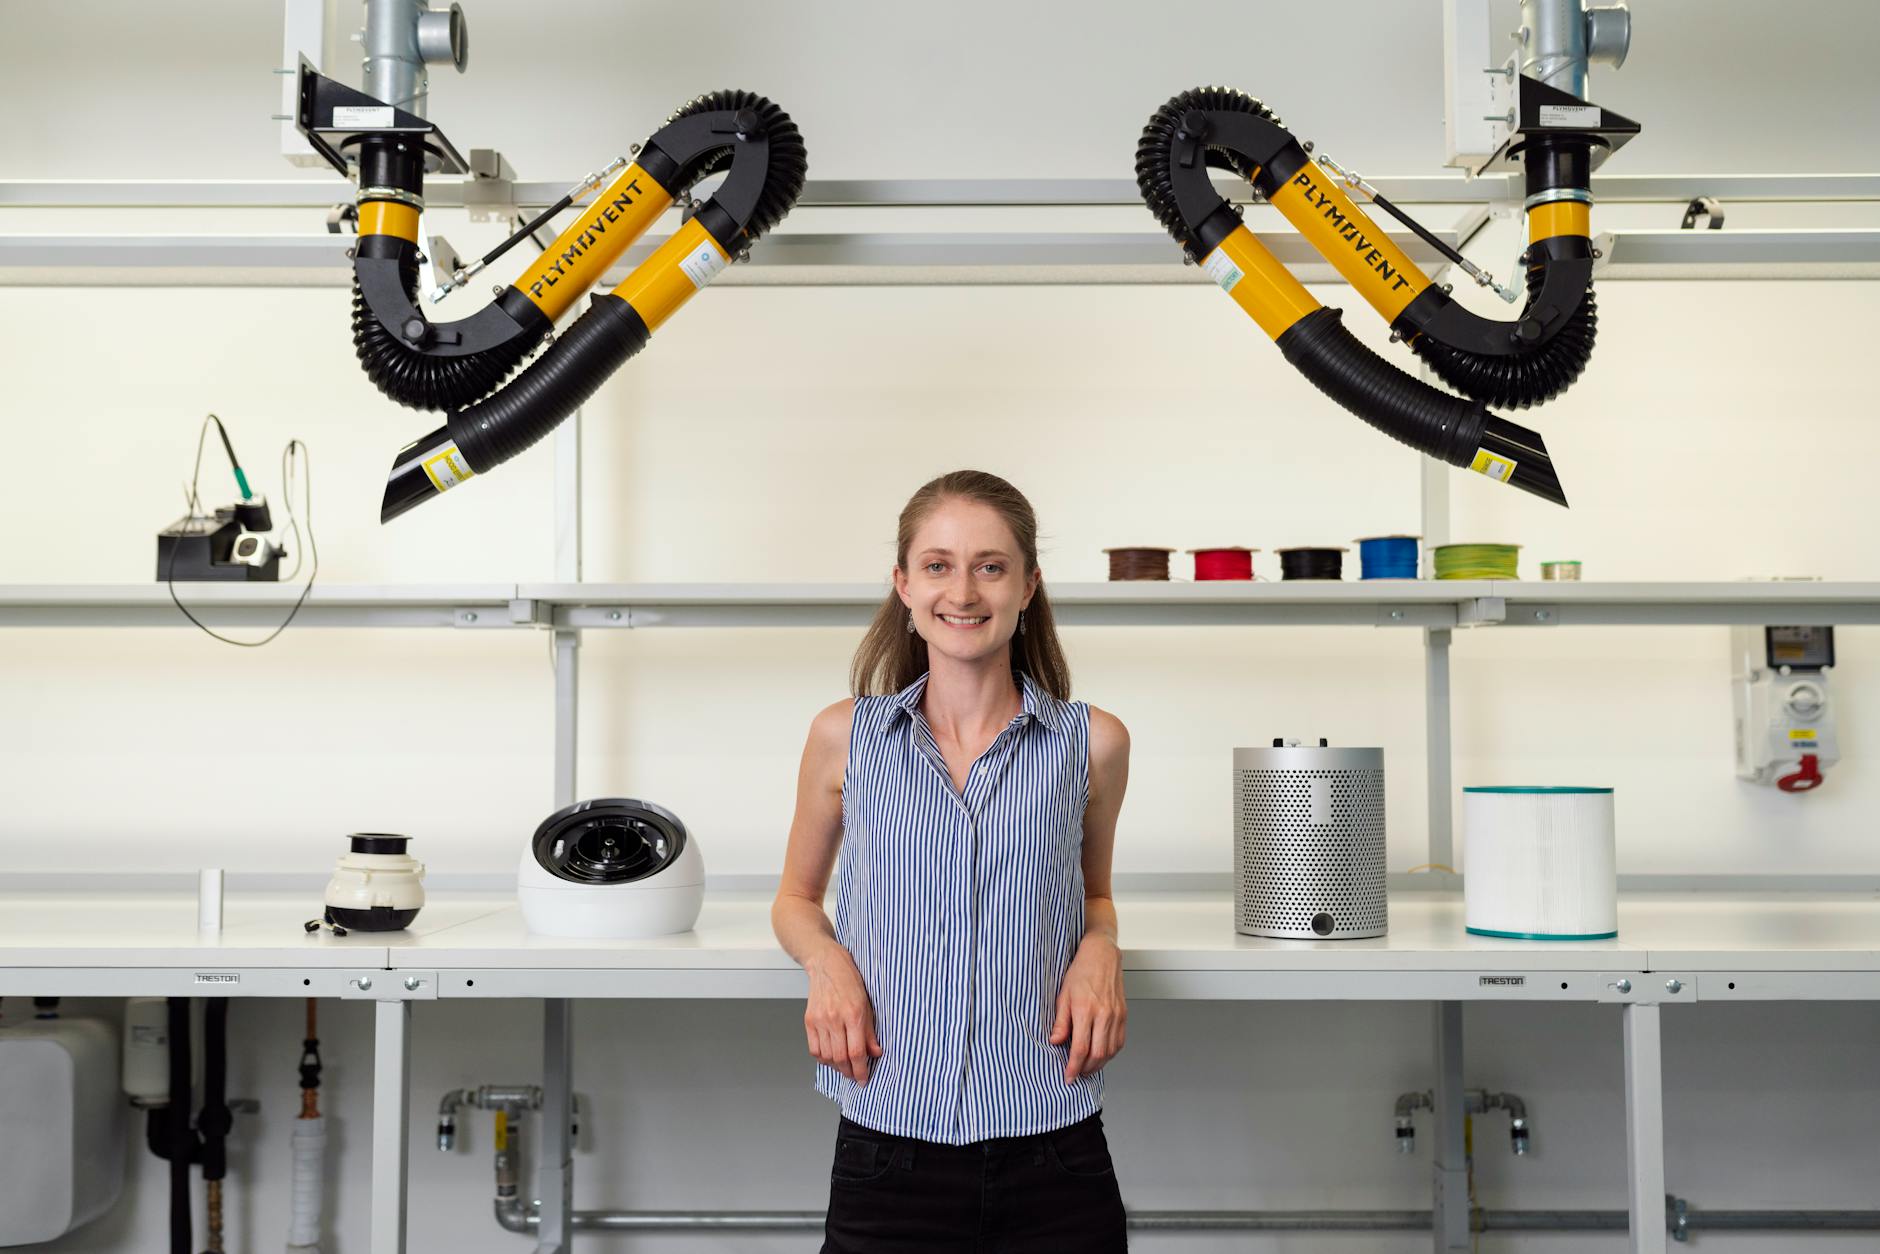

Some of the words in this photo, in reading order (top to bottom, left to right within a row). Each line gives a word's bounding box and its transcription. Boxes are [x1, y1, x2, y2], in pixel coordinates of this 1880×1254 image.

[530, 179, 644, 298] PLYMOVENT
[1292, 172, 1410, 291] PLYMOVENT
[1483, 977, 1523, 985] TRESTON
